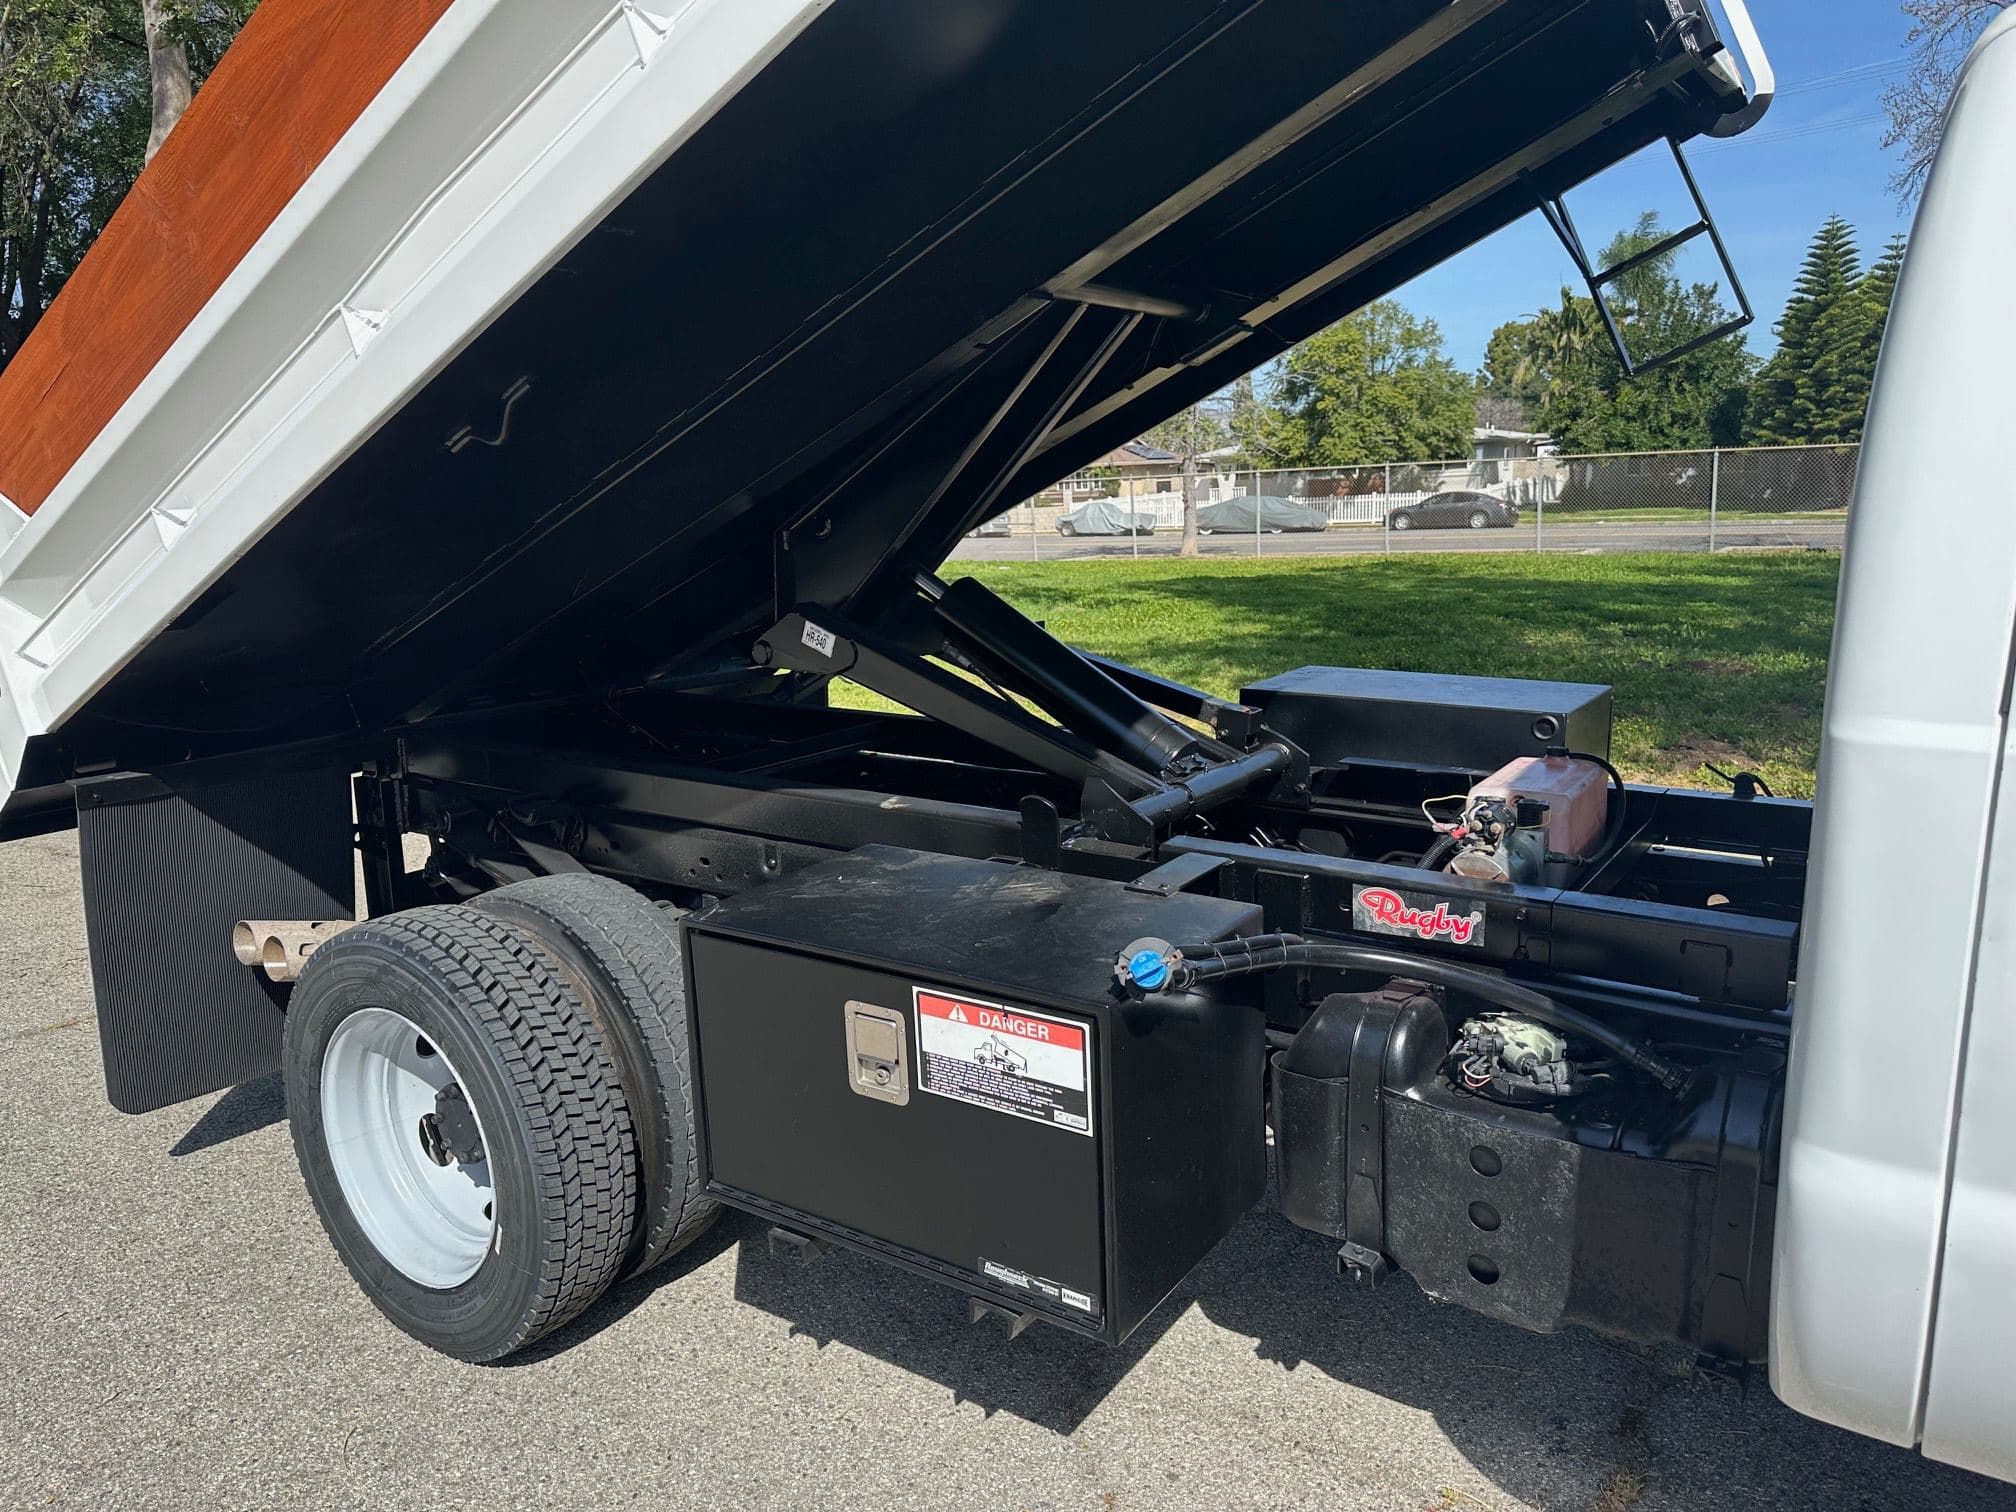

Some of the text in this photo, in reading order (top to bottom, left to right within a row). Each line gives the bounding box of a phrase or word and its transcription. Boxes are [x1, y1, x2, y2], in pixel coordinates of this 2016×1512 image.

[805, 628, 827, 649] HR-540
[1358, 887, 1474, 944] Rugby
[979, 1010, 1050, 1041] DANGER
